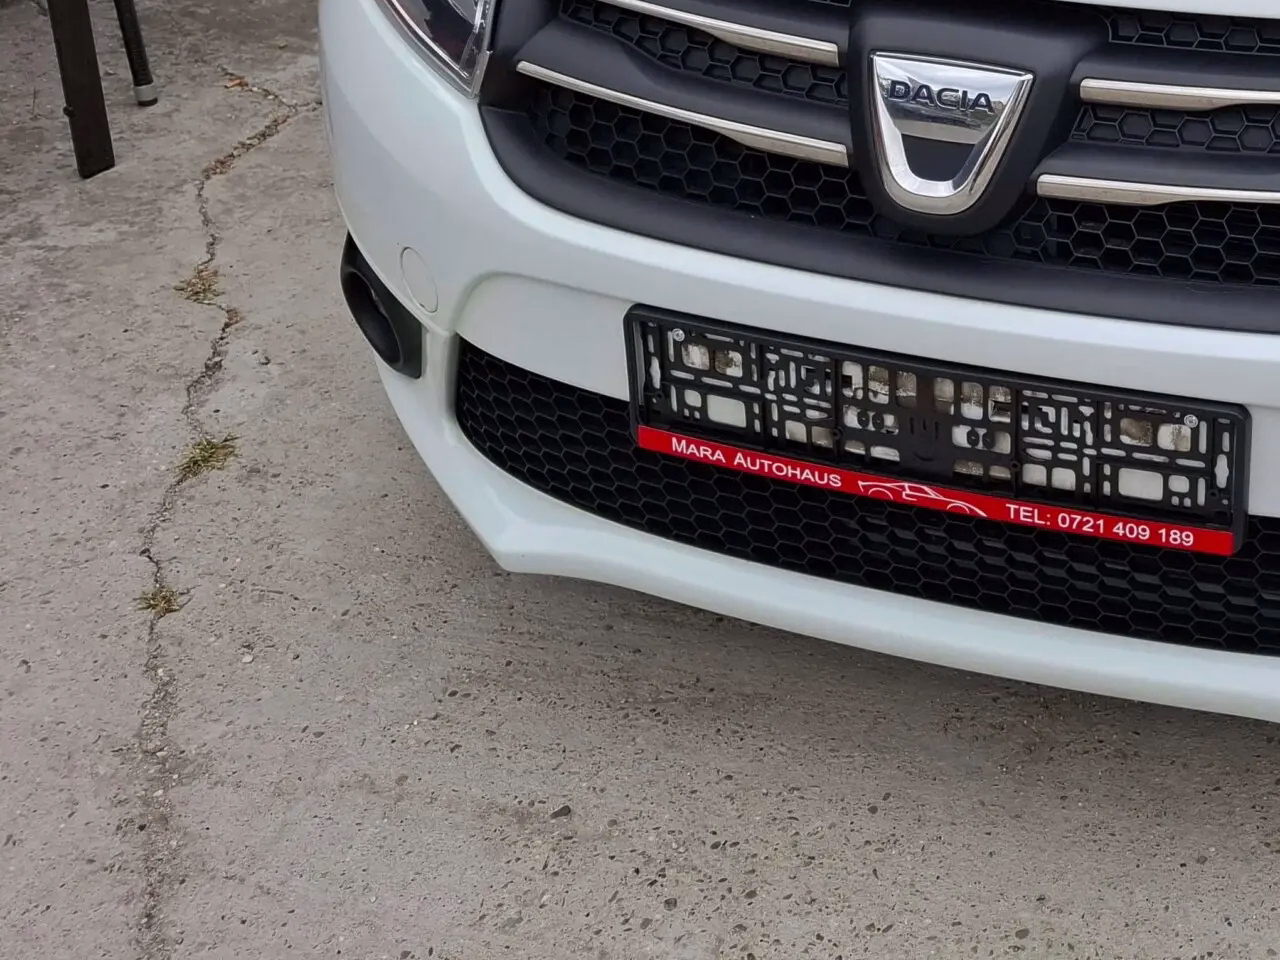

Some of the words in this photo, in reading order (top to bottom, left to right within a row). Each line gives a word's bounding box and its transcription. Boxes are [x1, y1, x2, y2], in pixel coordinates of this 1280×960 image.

[888, 79, 995, 115] DACIA
[671, 437, 725, 464] MARA
[733, 452, 842, 487] AUTOHAUS
[1005, 503, 1051, 526] TEL:
[1058, 512, 1104, 534] 0721
[1112, 523, 1150, 540] 409
[1158, 528, 1194, 546] 189
